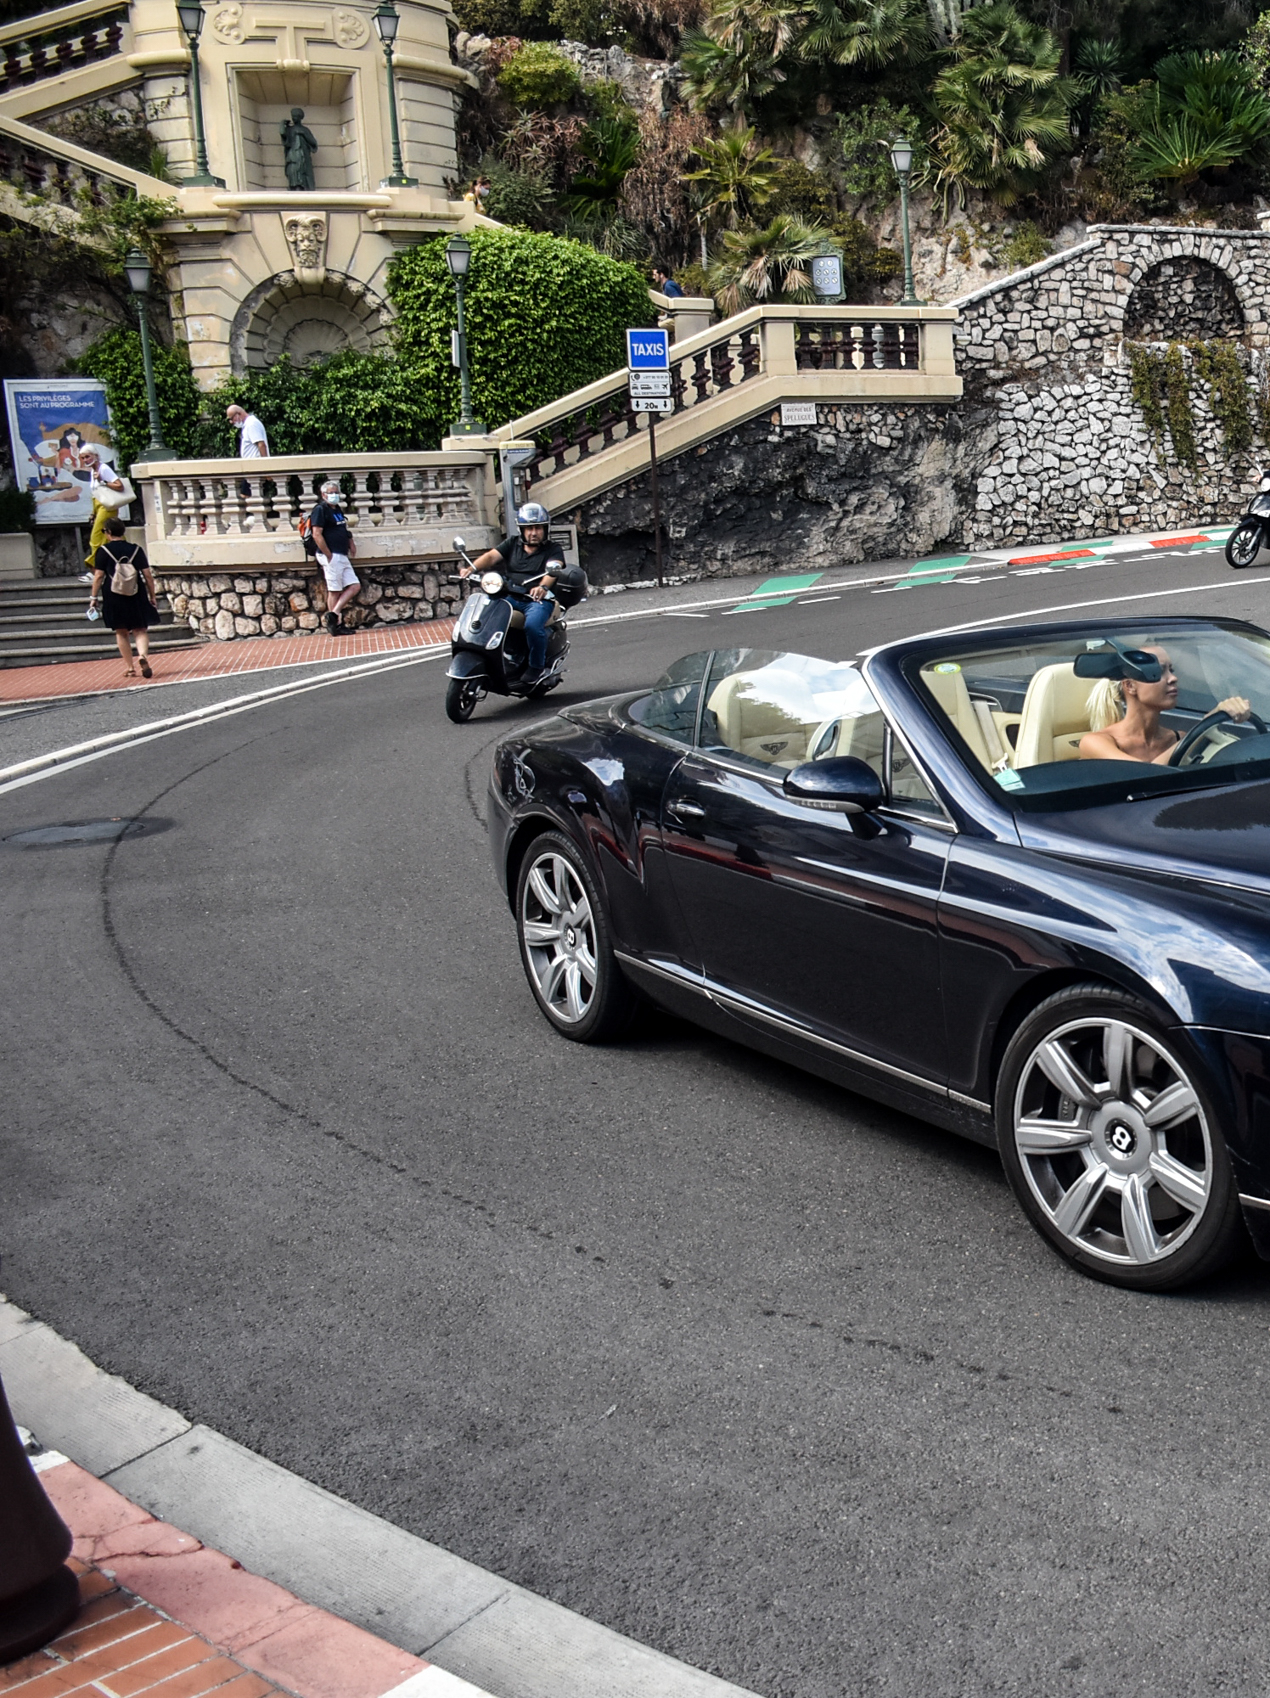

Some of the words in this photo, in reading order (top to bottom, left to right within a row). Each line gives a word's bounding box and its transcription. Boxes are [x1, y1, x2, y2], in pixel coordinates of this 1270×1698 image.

[631, 343, 665, 356] TAXIS
[32, 394, 71, 402] PRIVILÈGES
[50, 401, 95, 409] PROGRAMME
